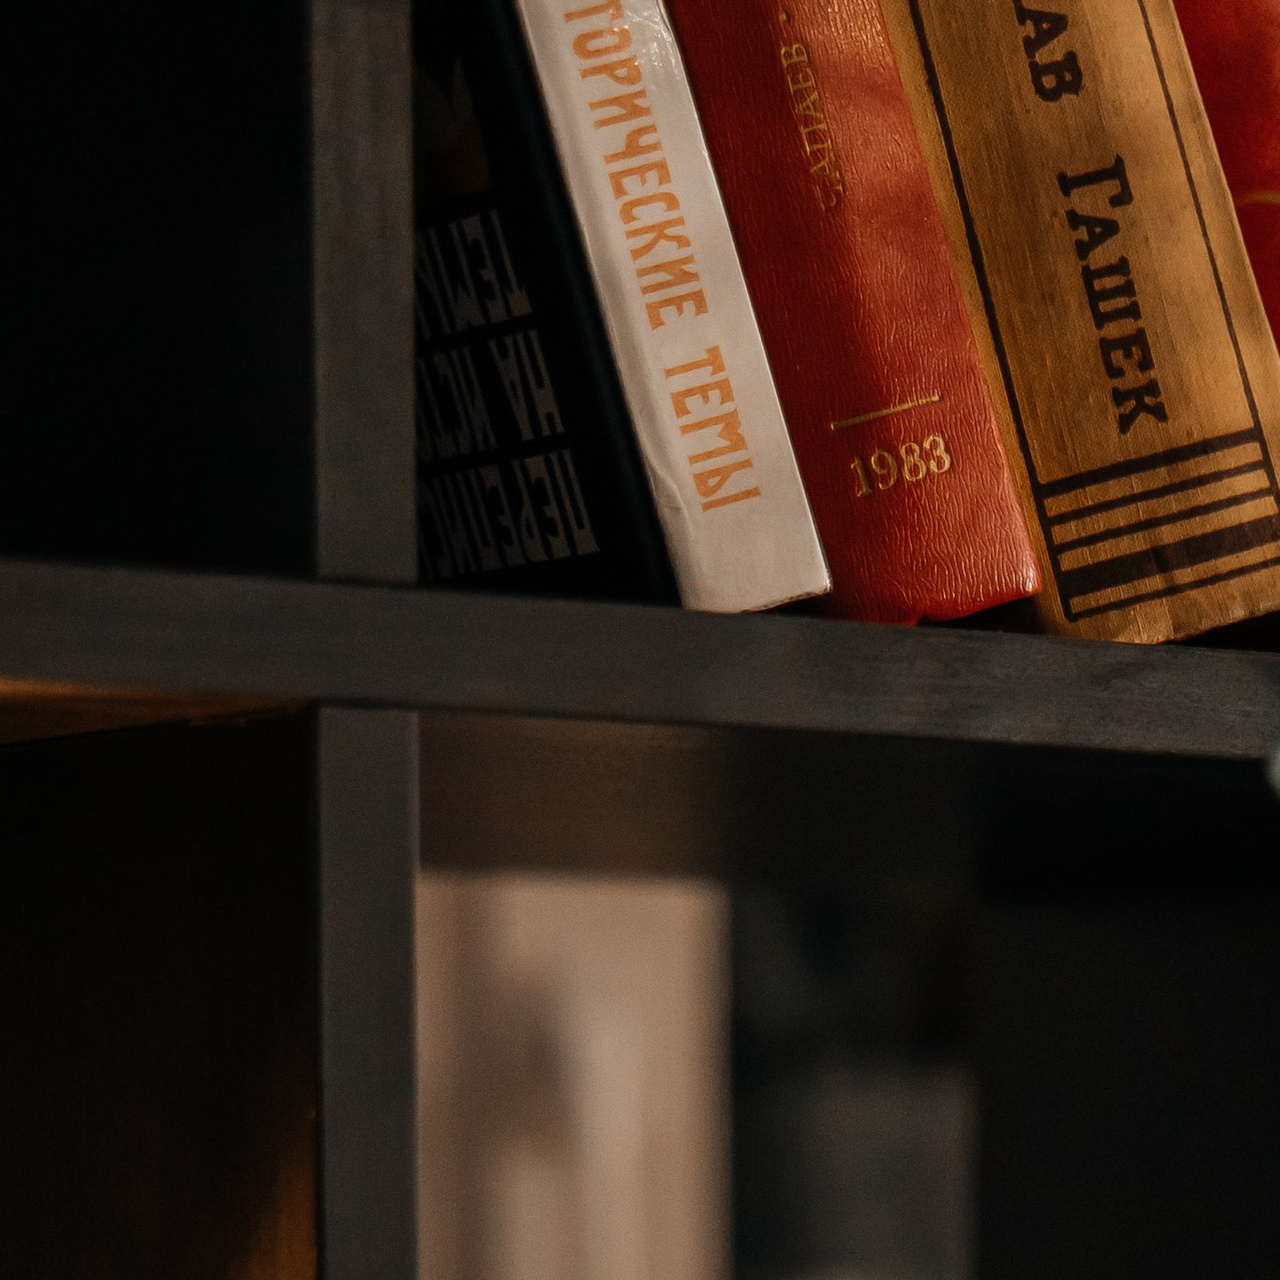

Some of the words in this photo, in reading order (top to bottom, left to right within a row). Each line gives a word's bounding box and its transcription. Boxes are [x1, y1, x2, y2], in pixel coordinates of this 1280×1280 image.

[562, 0, 709, 331] ТОРИЧЕСКИЕ
[664, 344, 762, 513] ТЕМЫ
[1056, 153, 1169, 436] ГАШЕК
[488, 329, 564, 442] НА
[416, 447, 600, 581] ПЕРЕПИС
[849, 434, 952, 498] 1983
